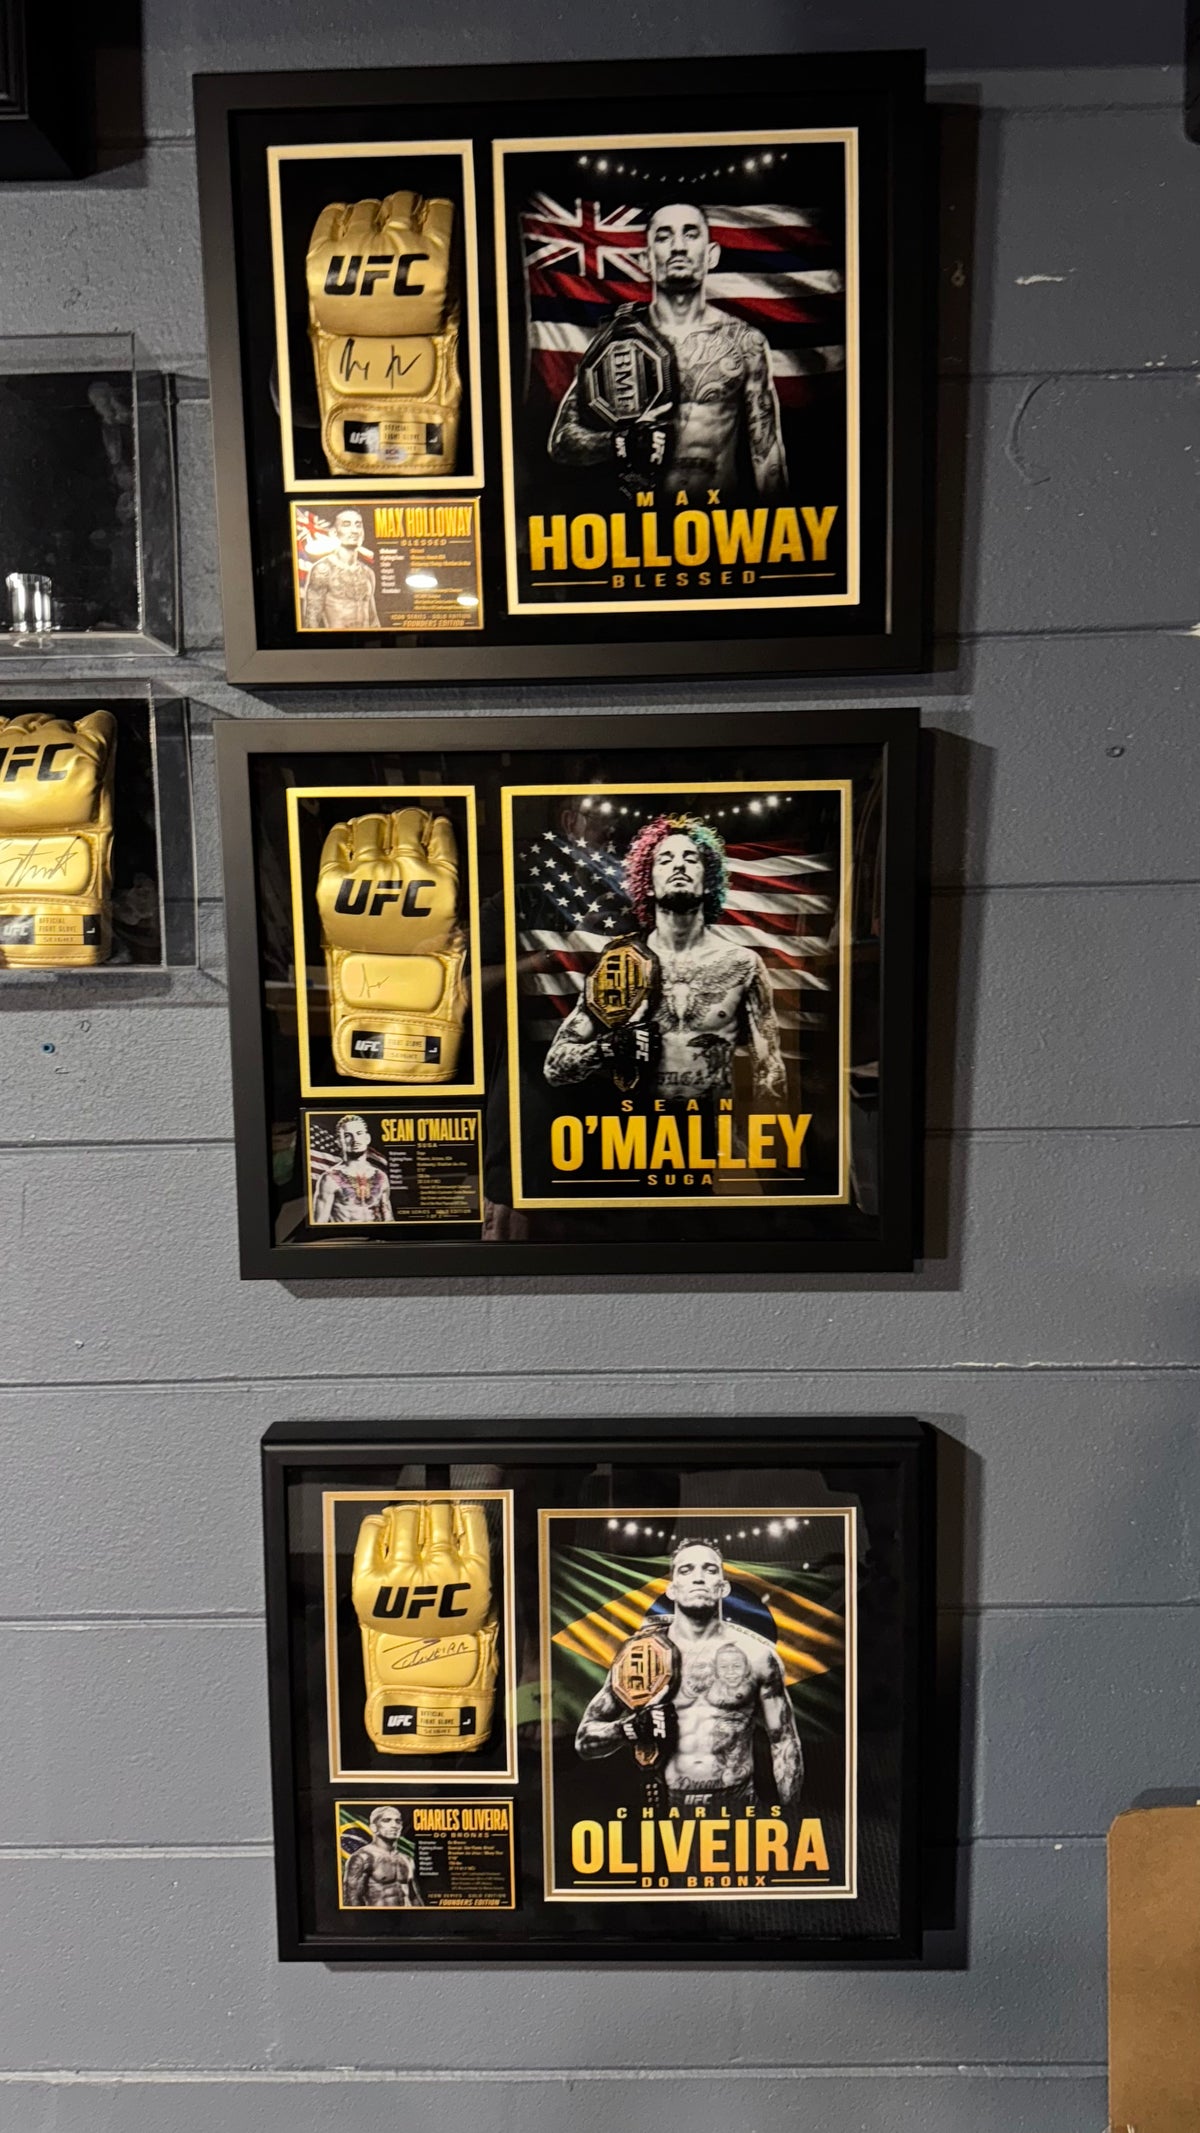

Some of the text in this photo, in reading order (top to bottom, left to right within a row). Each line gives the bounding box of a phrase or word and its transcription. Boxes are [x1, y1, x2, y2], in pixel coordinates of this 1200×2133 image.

[323, 254, 430, 297] UFC
[636, 489, 721, 507] MAX
[374, 506, 473, 538] MAX HOLLOWAY
[529, 505, 839, 571] HOLLOWAY
[611, 570, 756, 588] BLESSED
[0, 743, 75, 782] FC
[335, 878, 437, 918] UFC
[2, 923, 30, 937] UFC
[354, 1040, 381, 1053] UFC
[635, 1029, 650, 1062] UFC
[620, 1098, 734, 1113] SEAN
[381, 1117, 477, 1142] SEAN O'MALLEY
[550, 1113, 813, 1172] O'MALLEY
[646, 1173, 714, 1186] SUGA
[372, 1582, 472, 1619] UFC
[387, 1714, 414, 1728] UFC
[650, 1710, 667, 1739] UFC
[684, 1793, 713, 1806] UFC
[413, 1808, 509, 1832] CHARLES OLIVEIRA
[616, 1805, 782, 1819] CHARLES
[571, 1818, 830, 1874] OLIVEIRA
[641, 1874, 767, 1888] DO BRONX
